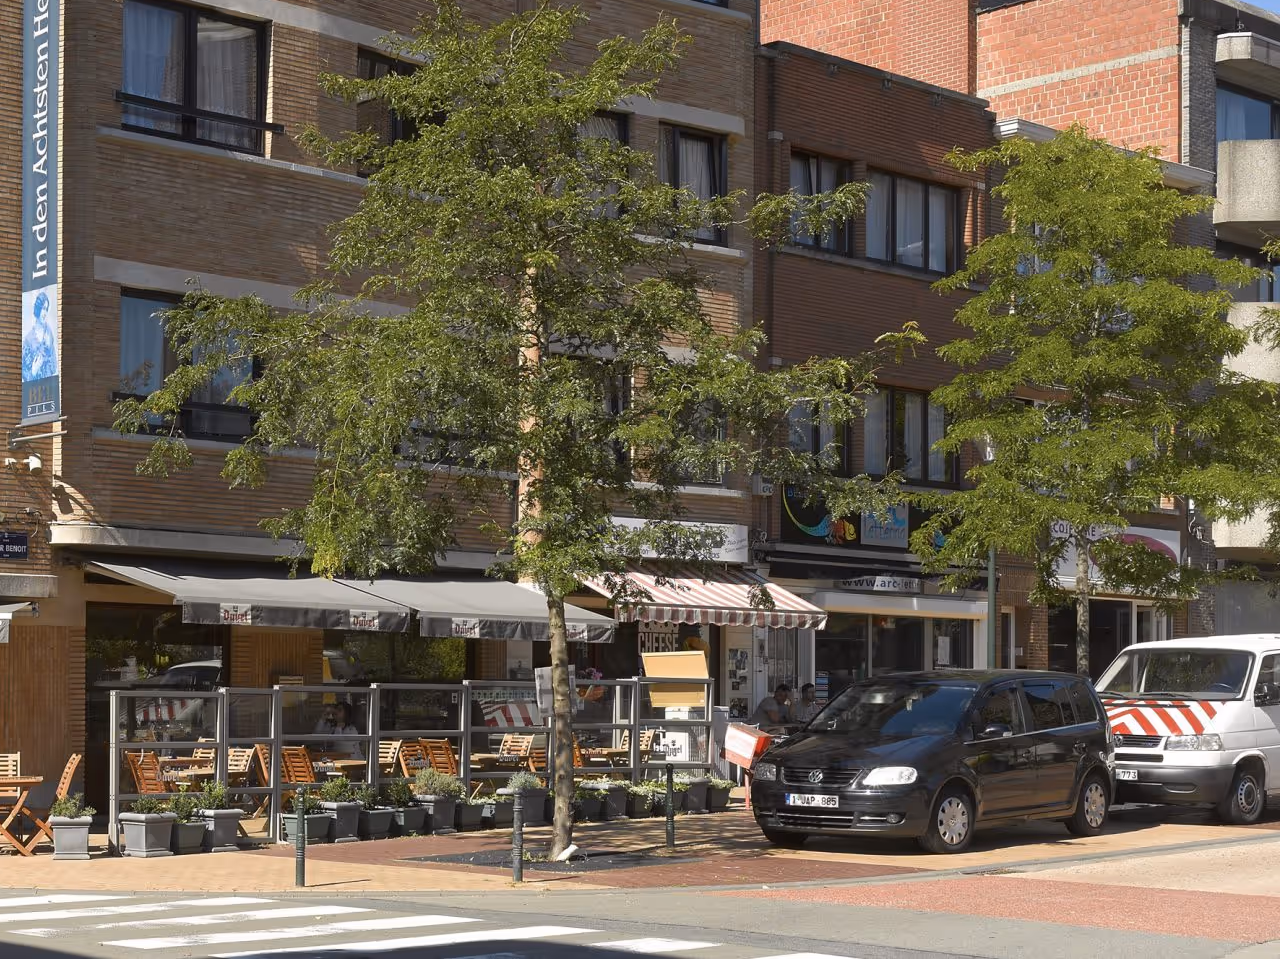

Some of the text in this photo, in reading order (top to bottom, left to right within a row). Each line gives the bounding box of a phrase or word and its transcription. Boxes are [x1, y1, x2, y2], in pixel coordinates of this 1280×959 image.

[32, 39, 50, 176] Achtsten
[32, 180, 48, 243] den
[32, 246, 48, 280] In
[27, 402, 56, 416] PILS
[5, 544, 27, 553] BENOIT
[223, 609, 249, 622] Duvel
[352, 615, 377, 627] Duvel
[638, 632, 679, 656] CHEESE
[314, 762, 335, 772] Duvel
